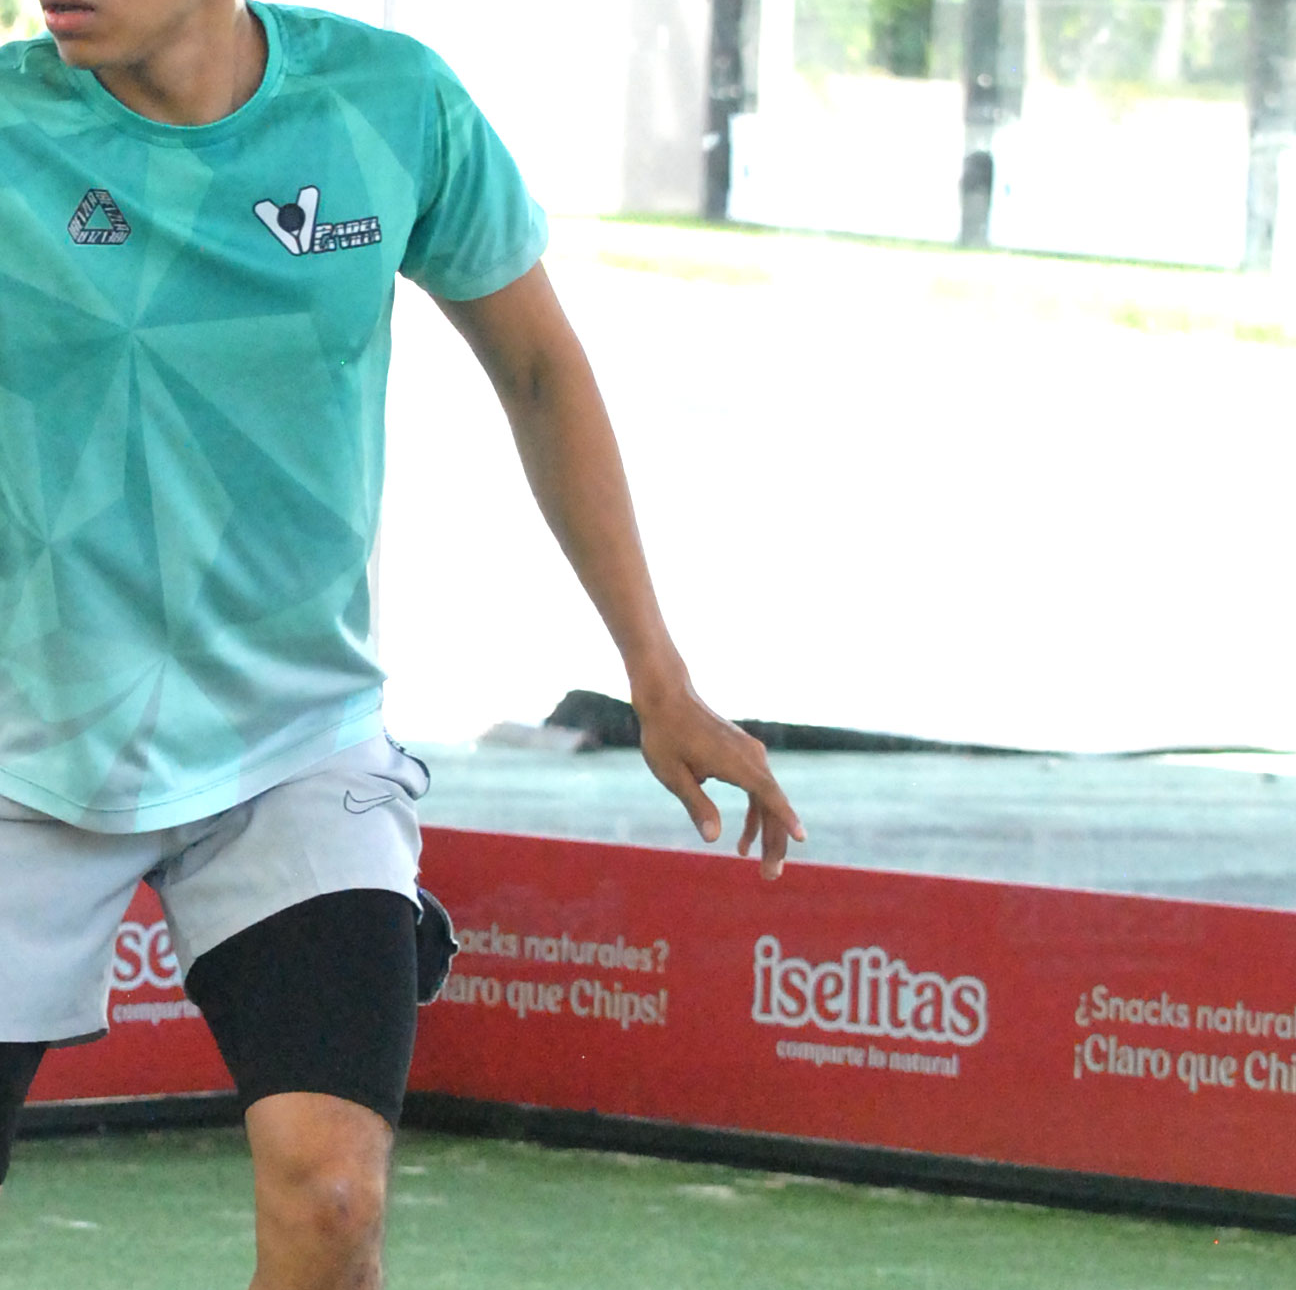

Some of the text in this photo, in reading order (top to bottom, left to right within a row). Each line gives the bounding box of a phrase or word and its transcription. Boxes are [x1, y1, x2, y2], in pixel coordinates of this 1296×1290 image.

[524, 931, 670, 974] naturales?
[506, 979, 564, 1019] que
[570, 978, 669, 1031] Chips!
[751, 934, 988, 1047] iselitas
[1075, 984, 1191, 1030] ¿Snacks
[1074, 1033, 1171, 1080] ¡Claro
[1177, 1051, 1238, 1094] que
